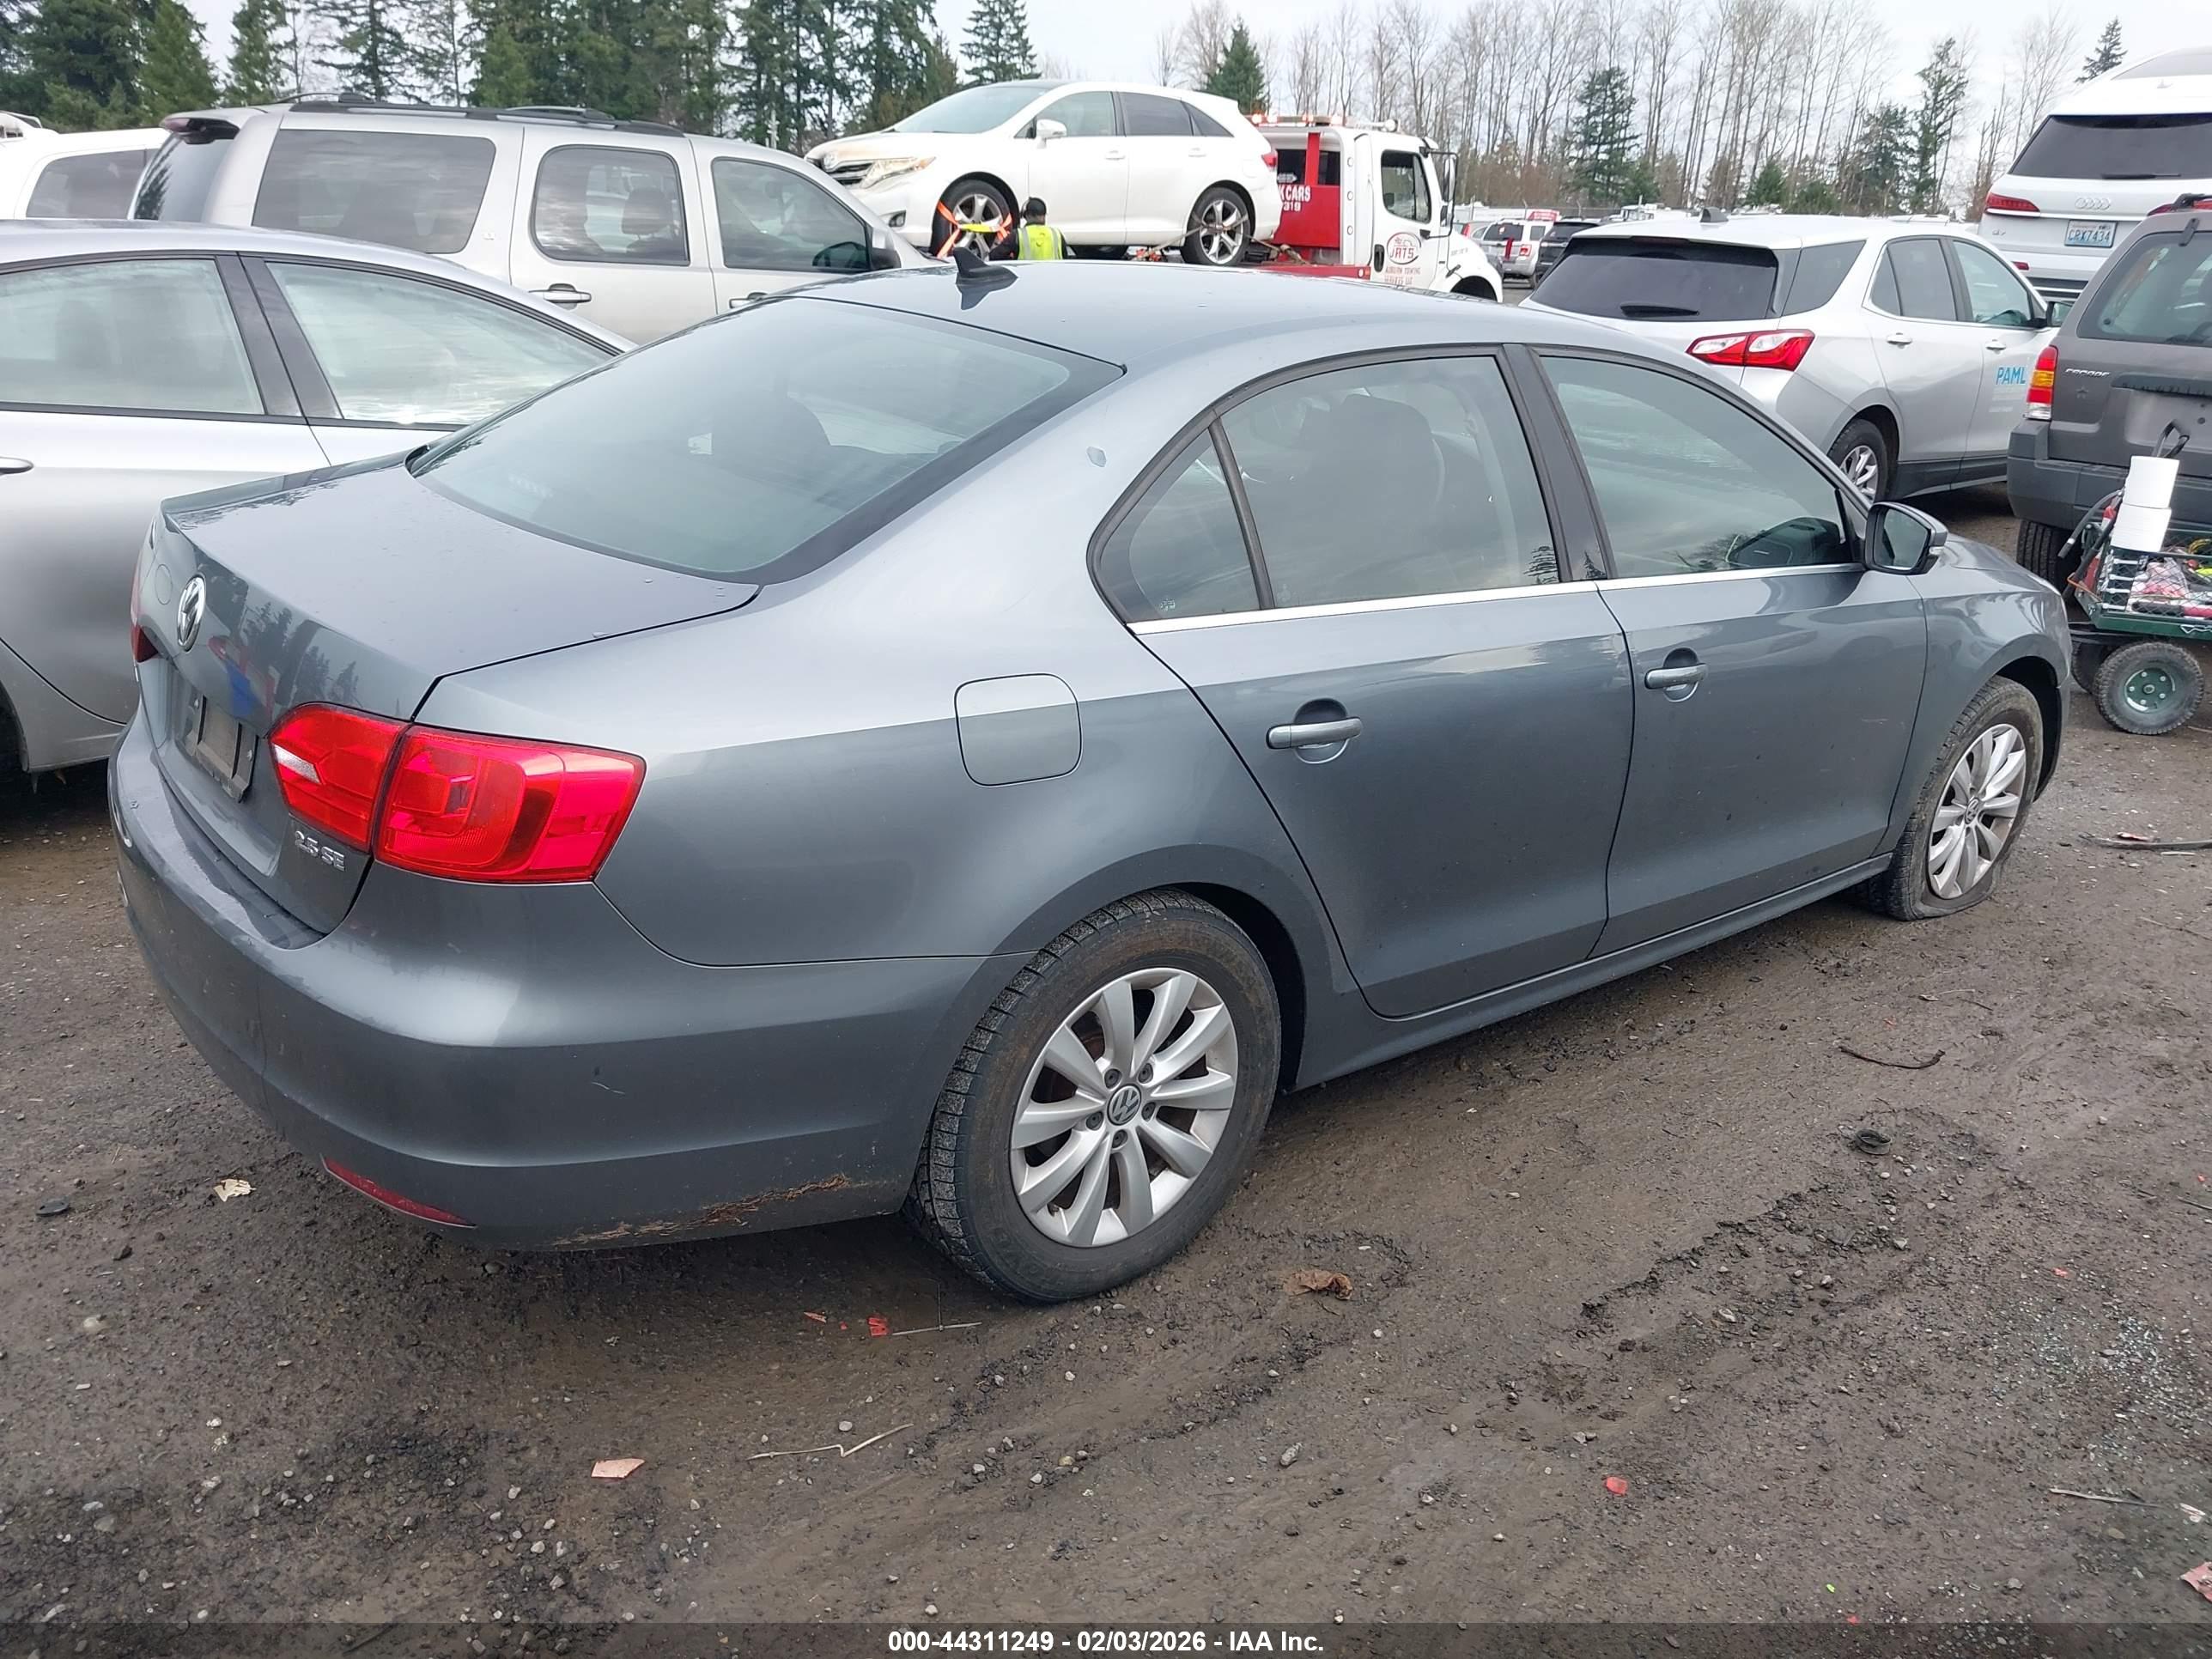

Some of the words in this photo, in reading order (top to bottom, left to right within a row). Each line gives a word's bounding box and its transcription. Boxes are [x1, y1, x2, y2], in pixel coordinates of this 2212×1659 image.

[1285, 185, 1311, 203] CARS
[1996, 366, 2027, 386] PAML
[321, 846, 345, 872] SE
[1108, 1085, 1141, 1125] VW
